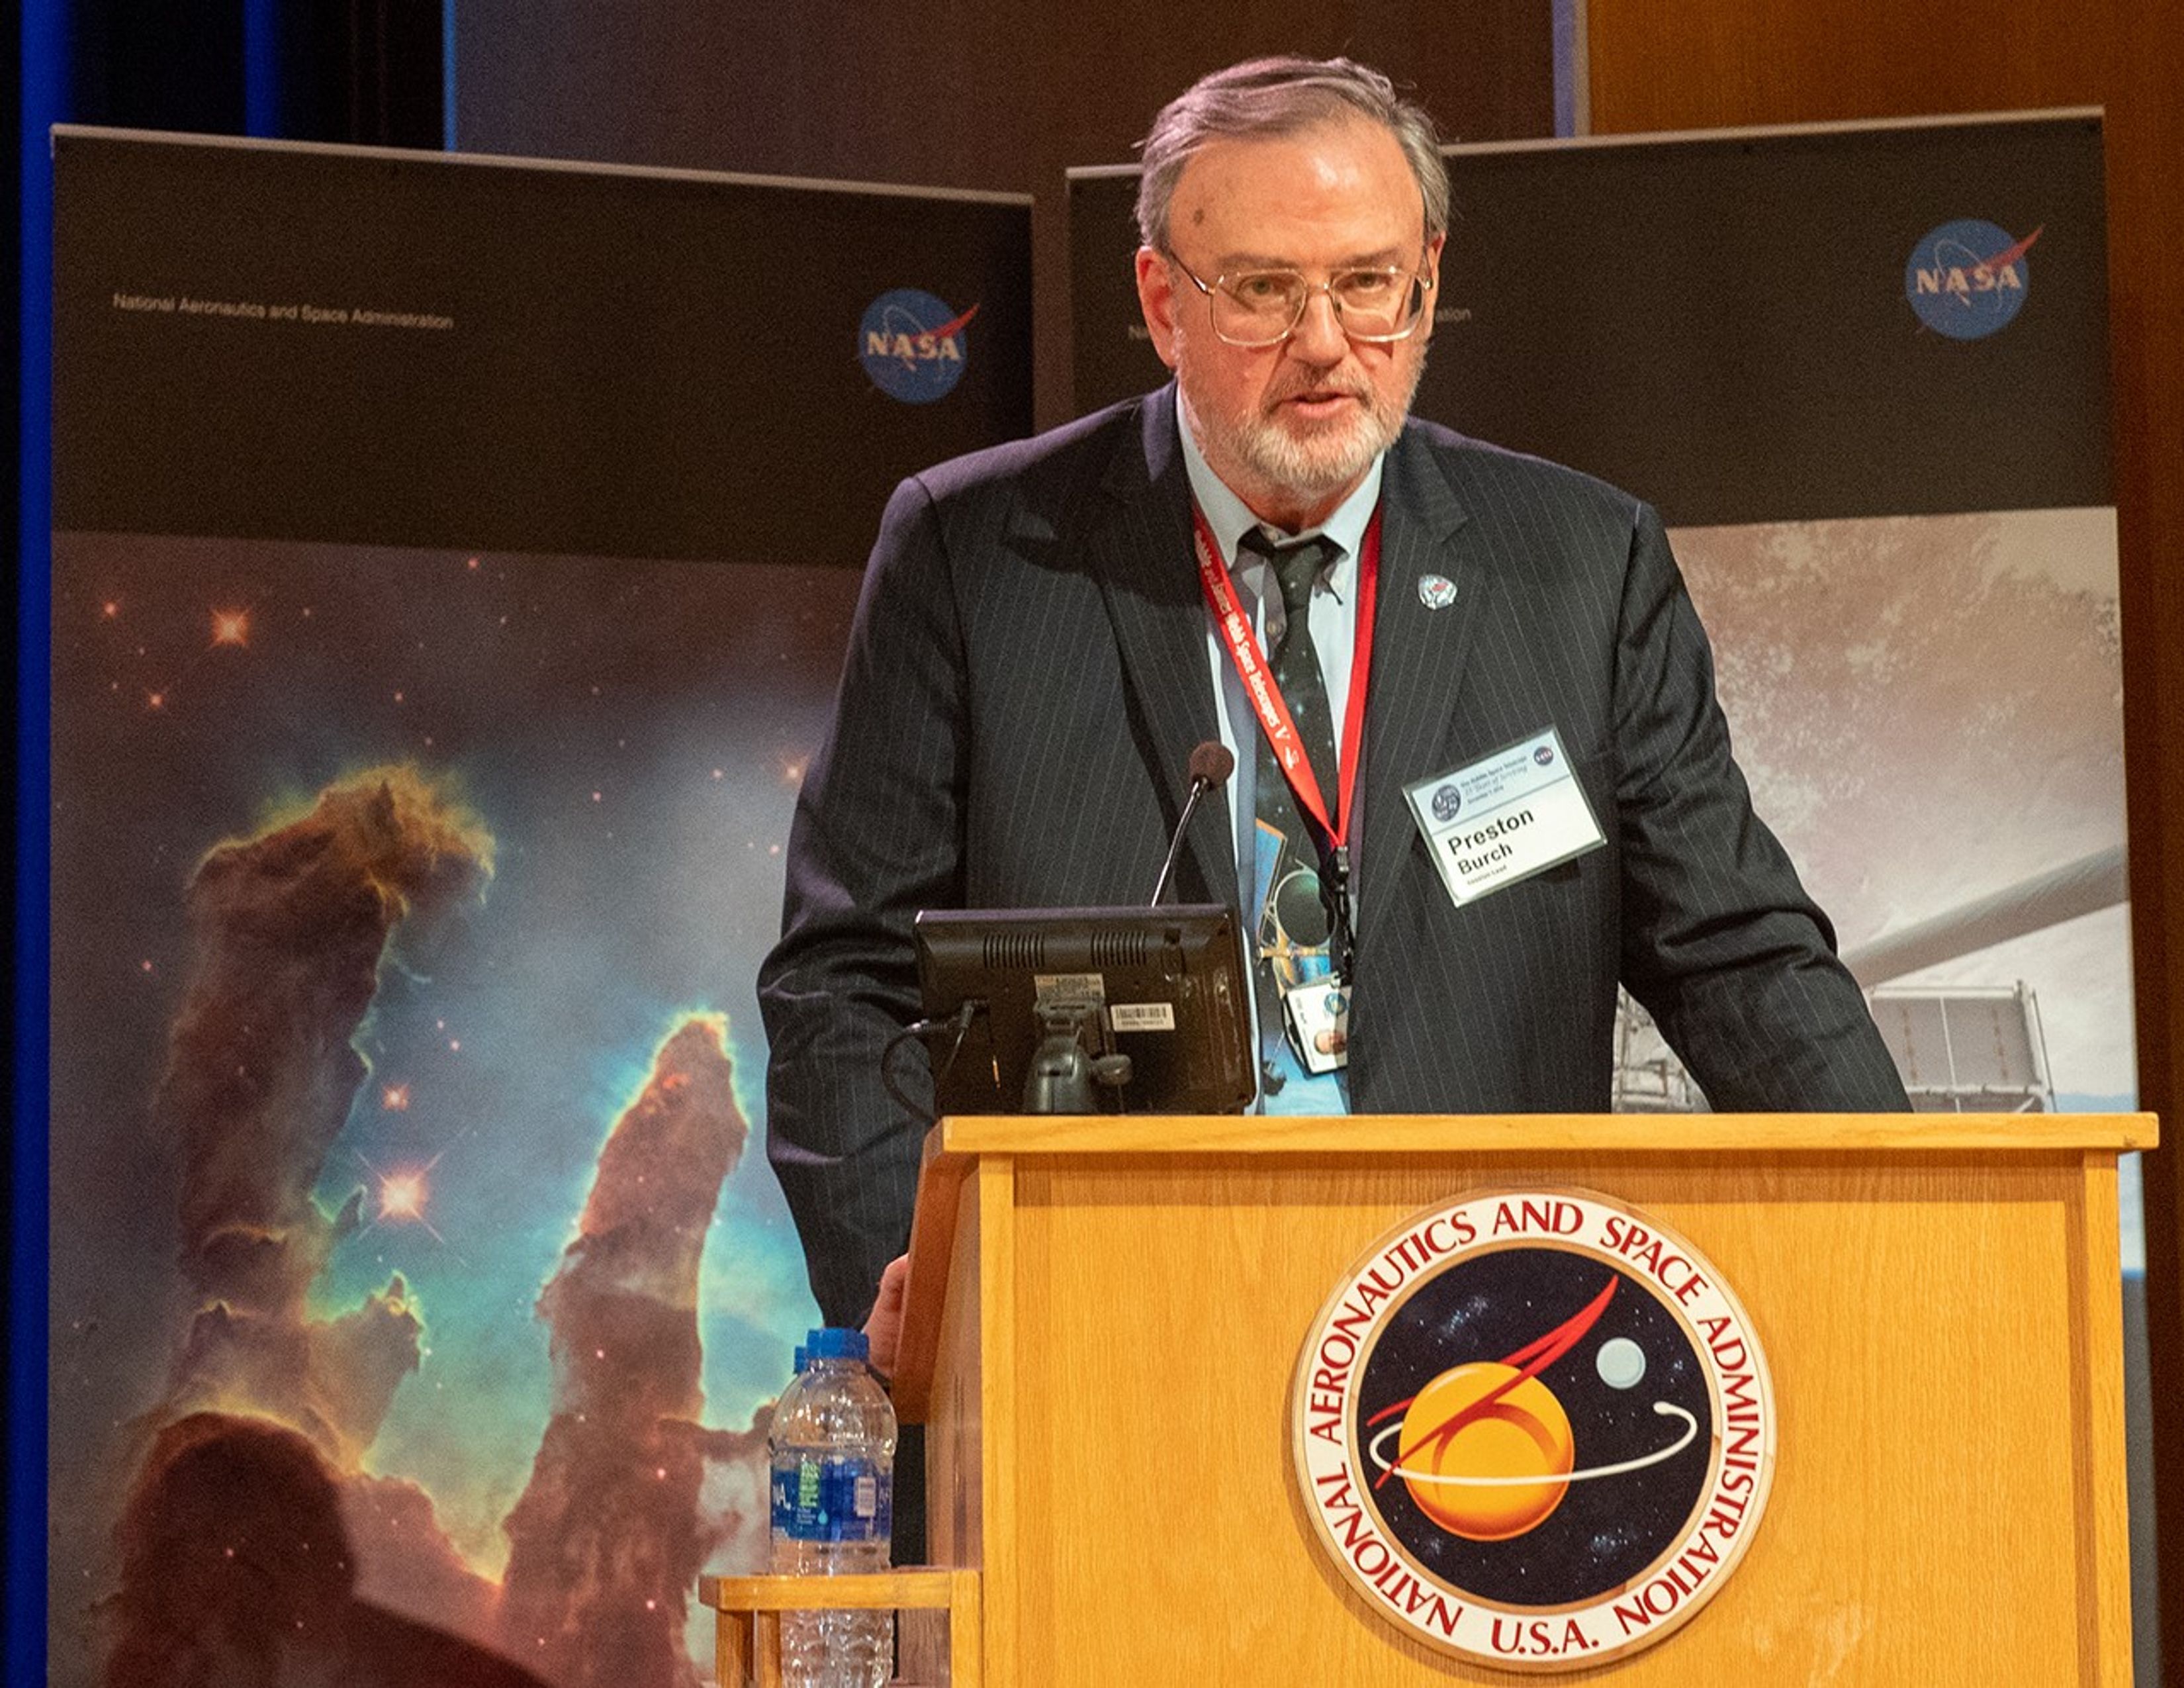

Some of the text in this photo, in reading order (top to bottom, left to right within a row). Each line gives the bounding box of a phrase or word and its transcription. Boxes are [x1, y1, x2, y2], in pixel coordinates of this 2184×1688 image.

[1916, 265, 2022, 295] NASA
[113, 292, 454, 329] National Aeronautics and Space Administration
[867, 331, 962, 362] NASA
[1236, 640, 1257, 675] Space
[1447, 810, 1534, 856] Preston
[1457, 843, 1513, 876] Burch
[1310, 1200, 1760, 1638] NATIONAL AERONAUTICS AND SPACE ADMINISTRATION
[1490, 1618, 1600, 1655] U.S.A.
